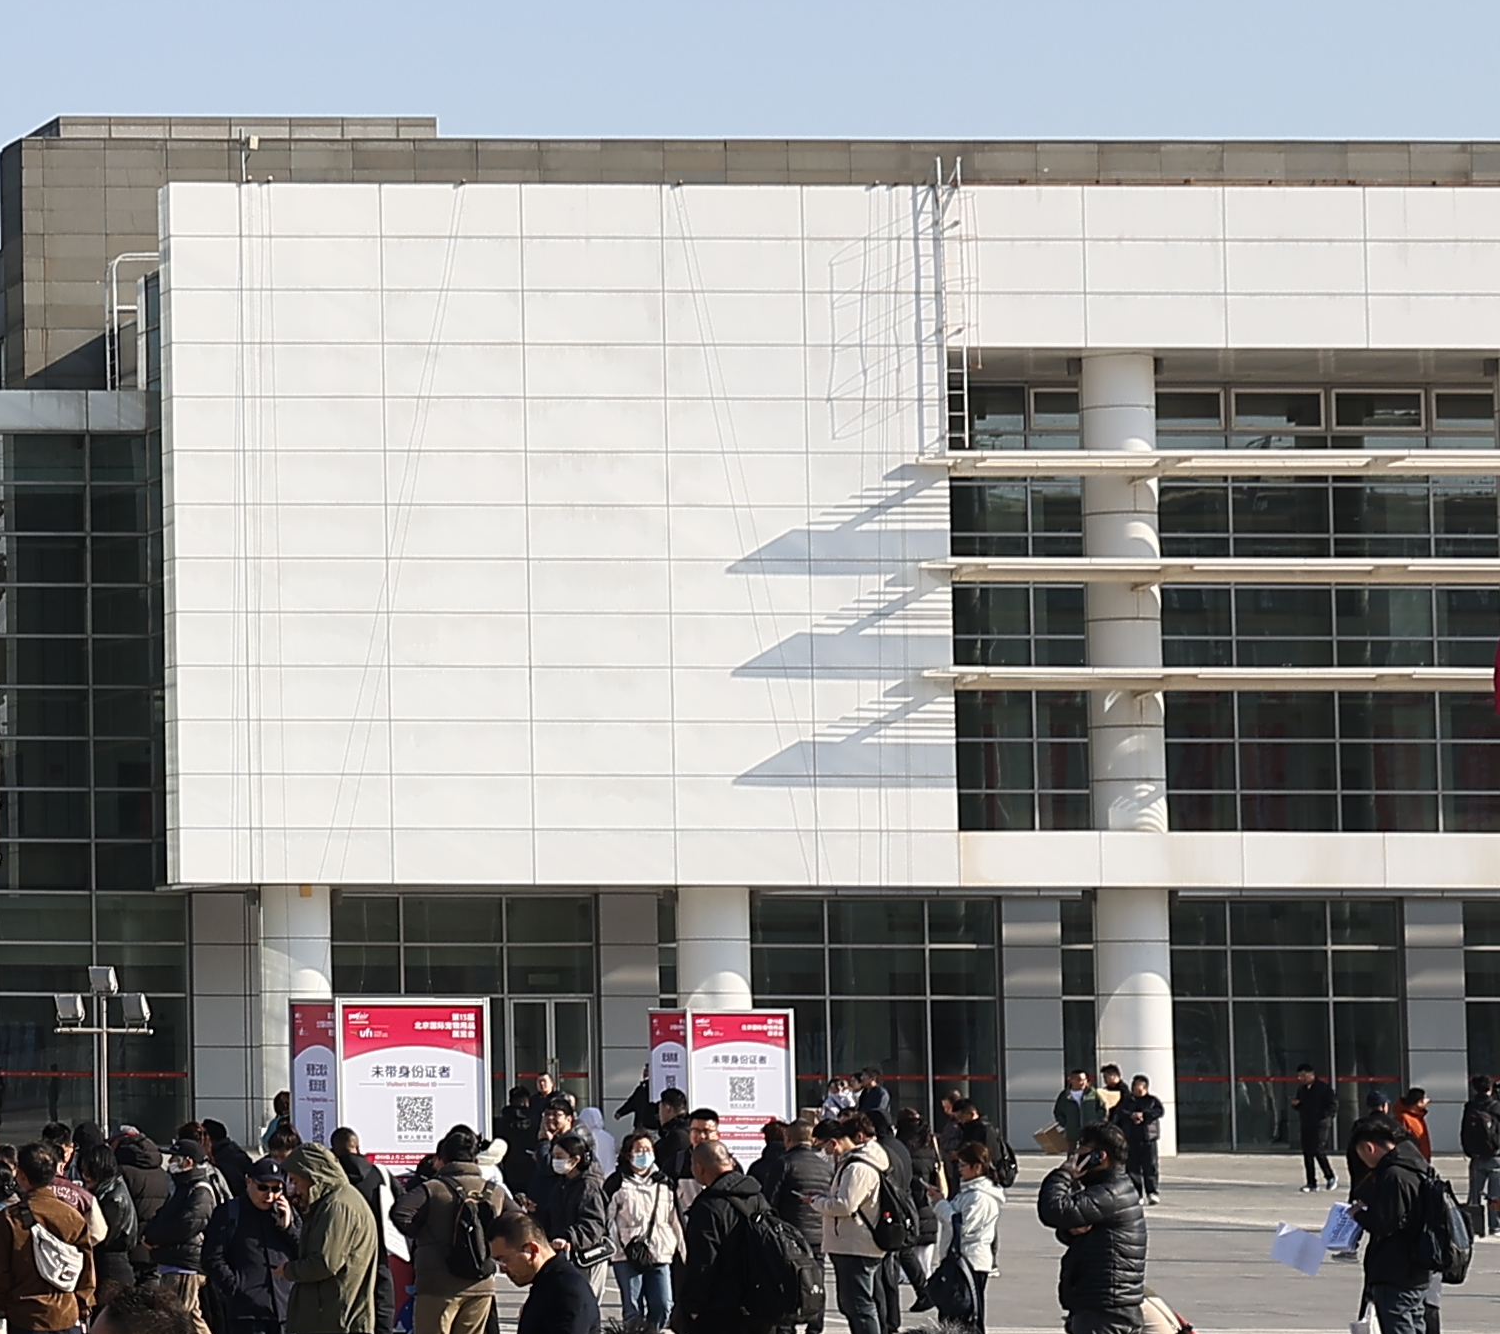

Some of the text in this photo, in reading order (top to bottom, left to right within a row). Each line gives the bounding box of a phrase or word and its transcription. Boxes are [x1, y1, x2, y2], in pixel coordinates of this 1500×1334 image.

[711, 1055, 767, 1065] 未带身份证者
[371, 1065, 451, 1078] 未带身份证者
